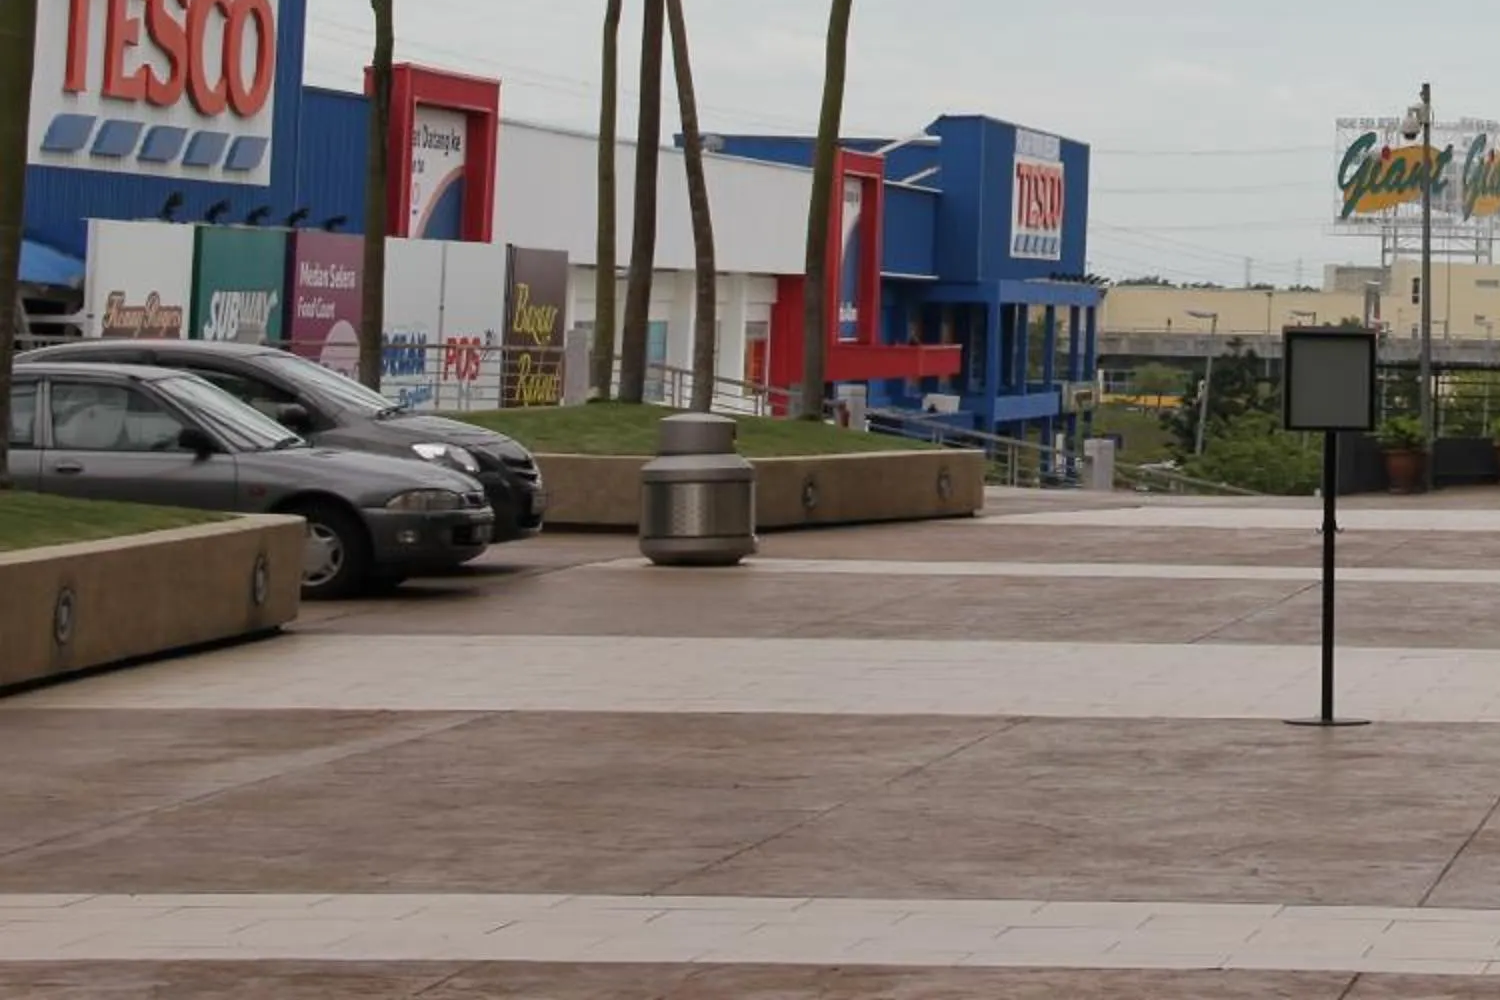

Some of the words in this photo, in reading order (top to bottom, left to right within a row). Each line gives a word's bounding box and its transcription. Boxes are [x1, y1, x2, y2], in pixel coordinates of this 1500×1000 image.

[1016, 161, 1065, 232] TESCO
[1338, 131, 1453, 220] Giant
[300, 261, 329, 289] Medan
[330, 263, 356, 289] Selera
[203, 289, 278, 344] SUBWAY
[297, 296, 316, 318] Food
[316, 297, 336, 319] Court
[443, 336, 481, 382] POS
